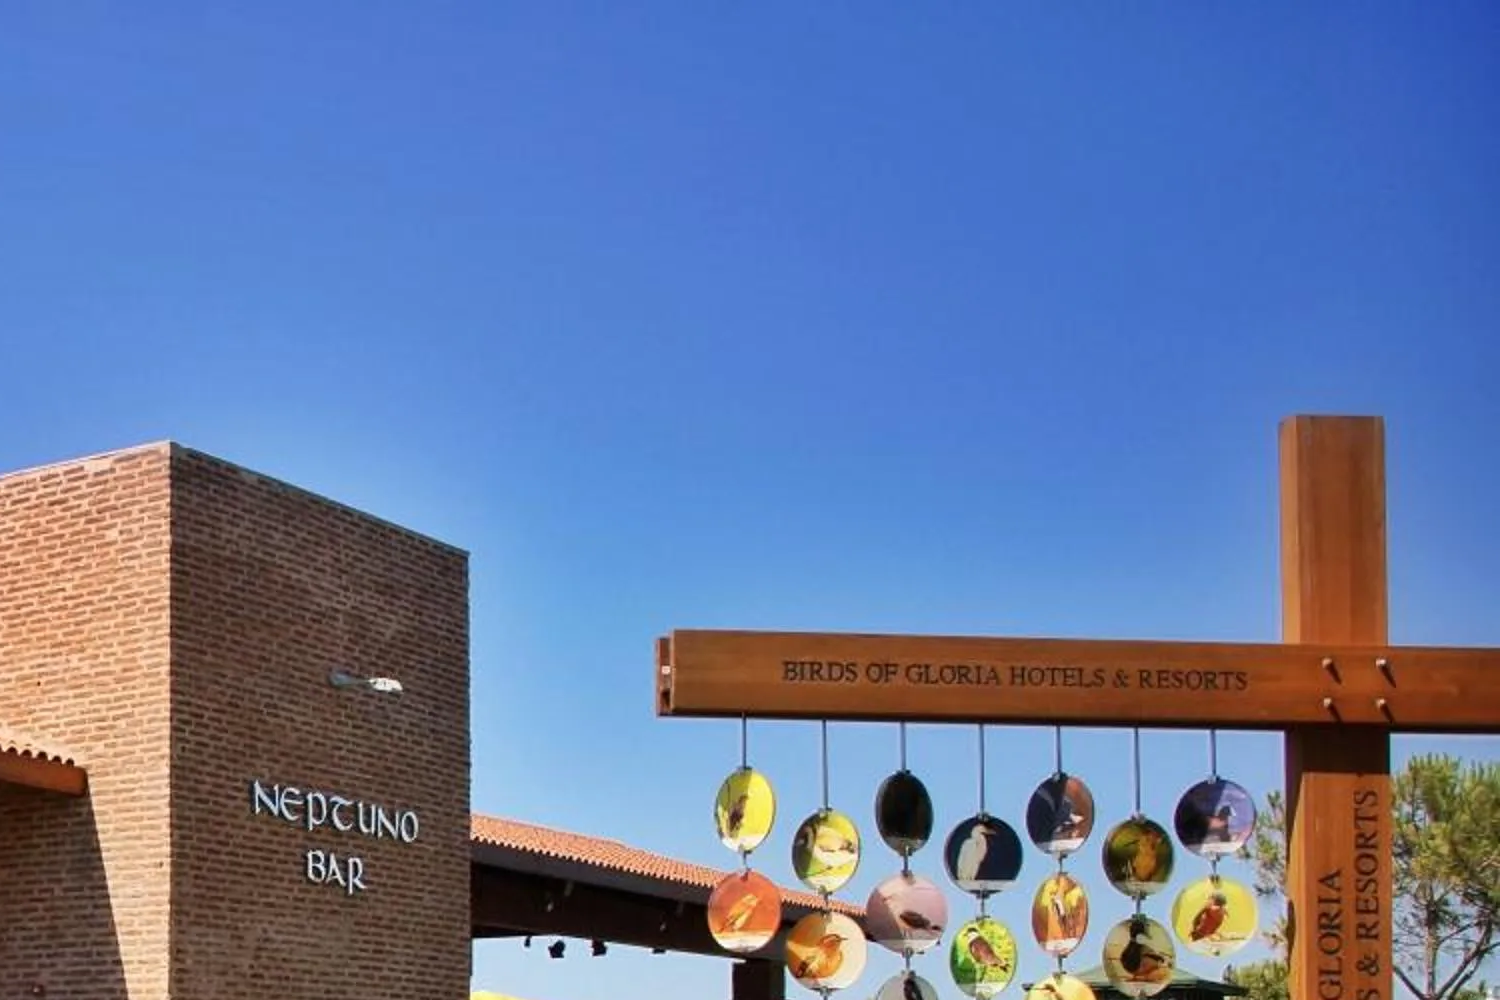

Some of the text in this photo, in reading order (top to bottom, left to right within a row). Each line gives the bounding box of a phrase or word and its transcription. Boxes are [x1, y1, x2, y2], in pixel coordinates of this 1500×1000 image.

[783, 661, 1248, 691] BIRDS OF GLORIA HOTELS & RESORTS
[254, 779, 419, 843] NEPTUNO
[307, 850, 367, 895] BAR
[1355, 788, 1380, 942] RESORTS
[1357, 957, 1380, 977] &
